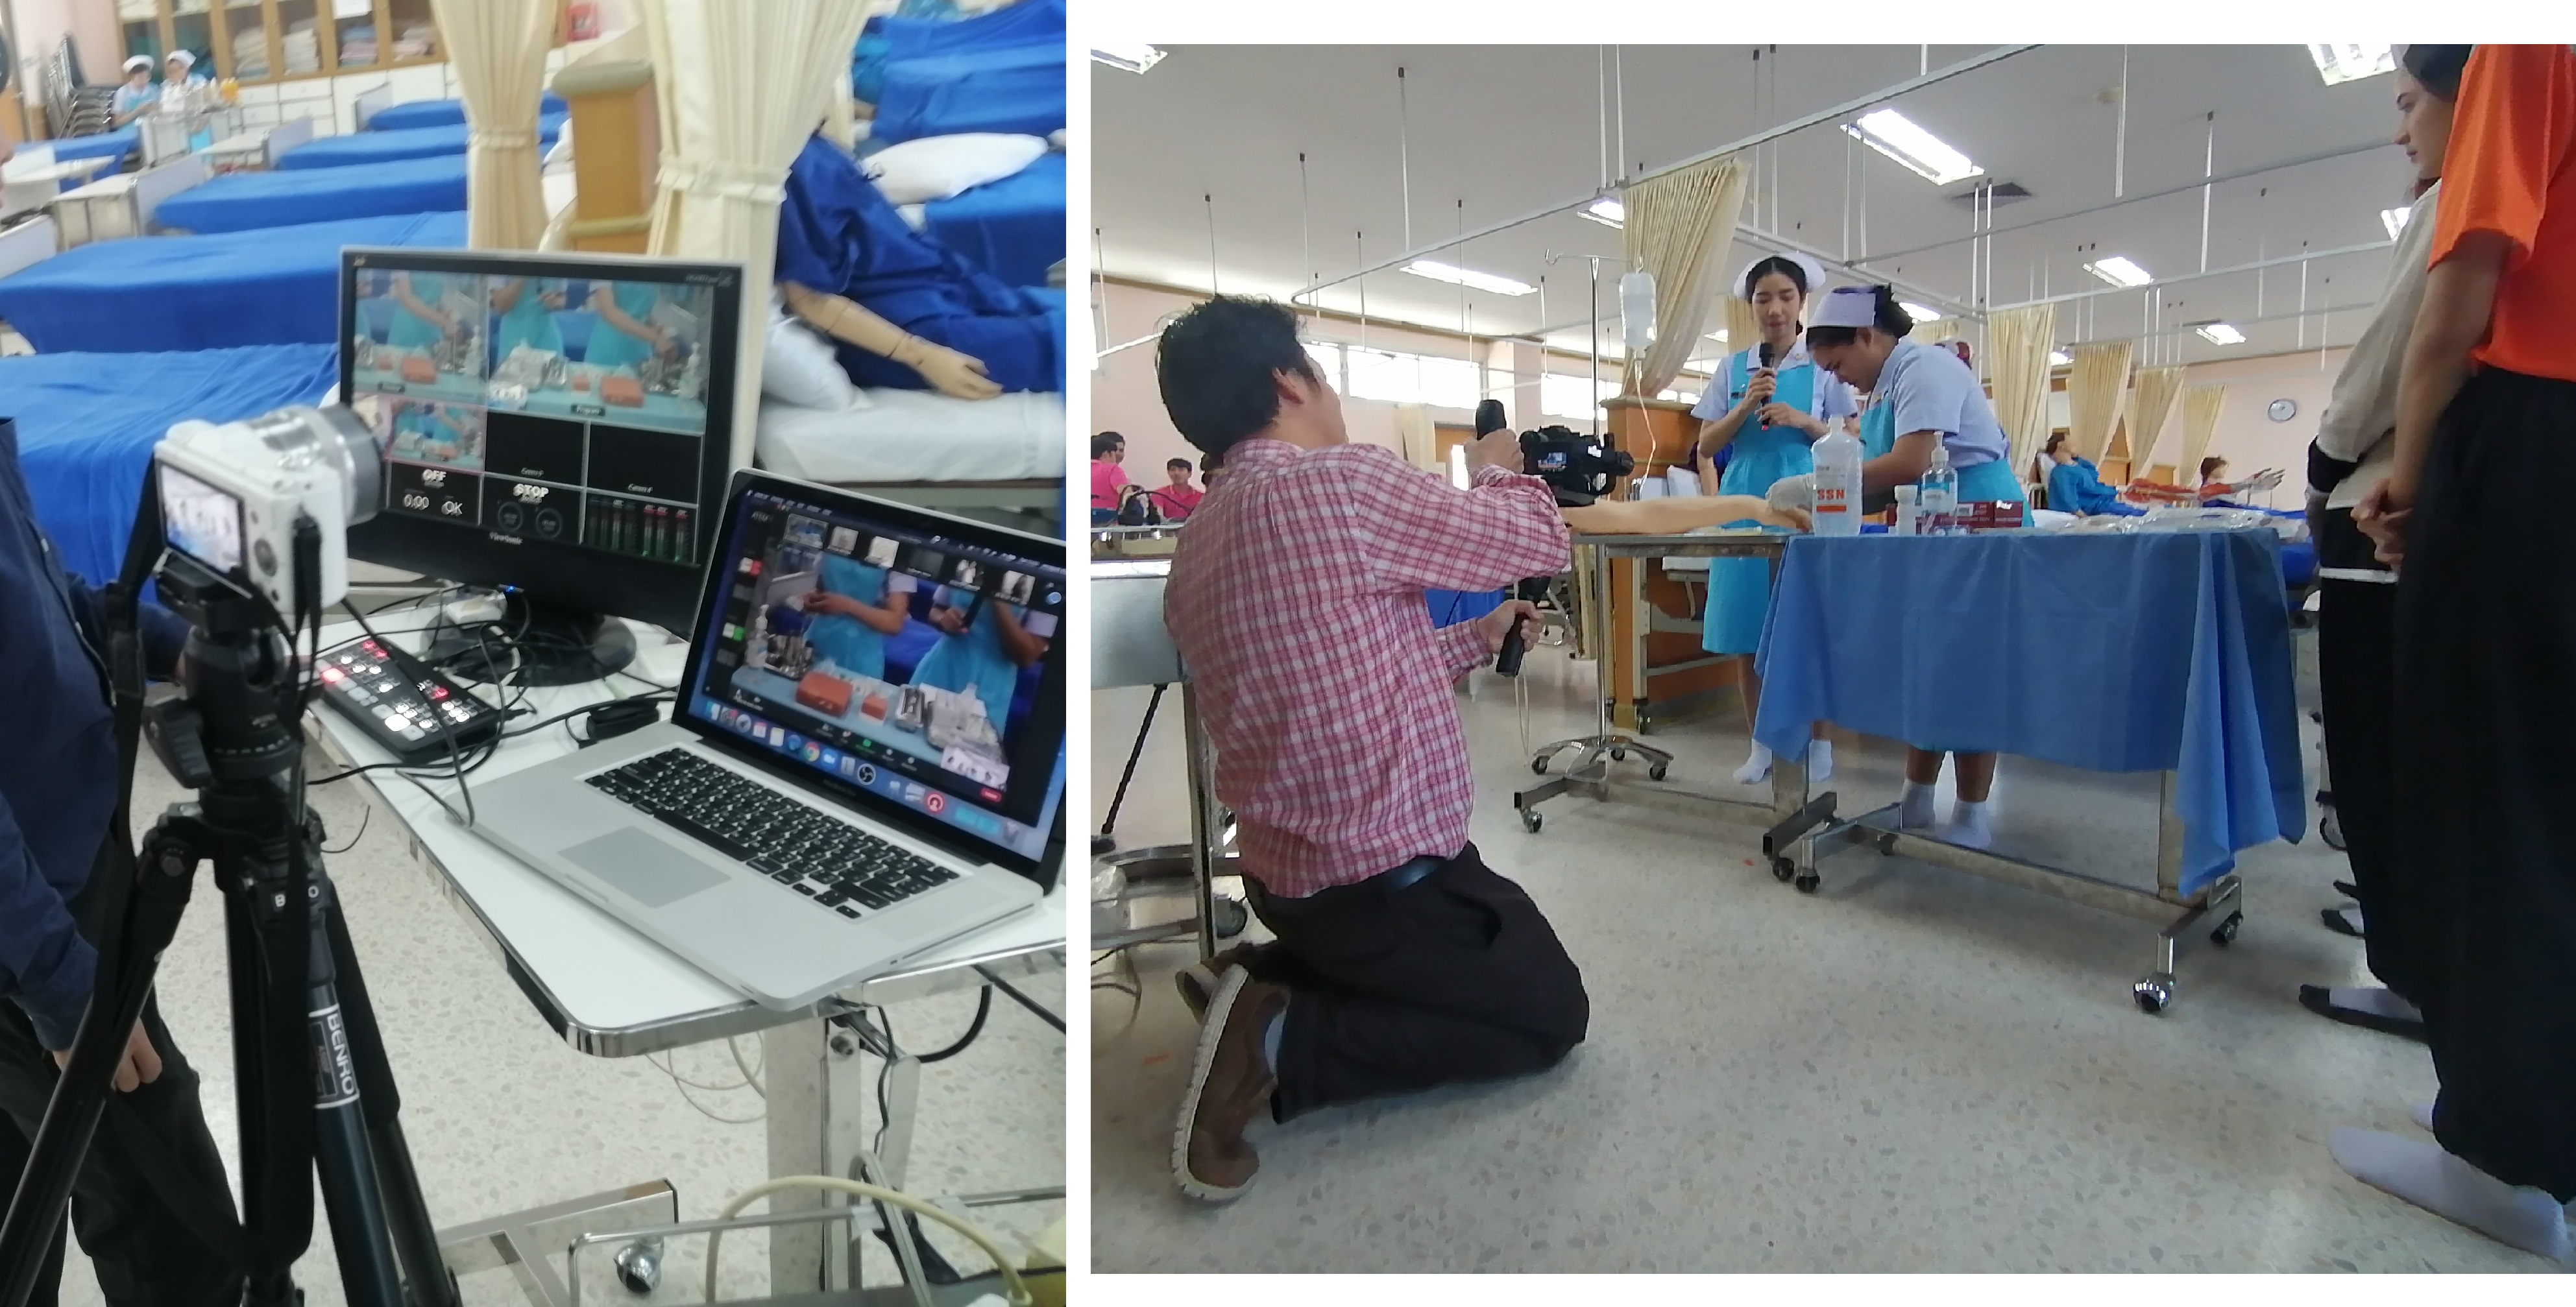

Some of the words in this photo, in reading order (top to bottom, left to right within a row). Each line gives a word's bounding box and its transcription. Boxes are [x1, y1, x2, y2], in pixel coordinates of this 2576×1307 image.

[422, 469, 447, 481] OFF
[513, 483, 549, 498] STOP
[1816, 488, 1845, 501] SSN
[403, 494, 430, 510] 0.00
[441, 501, 463, 517] OK
[489, 531, 524, 546] ViewSonic
[326, 1013, 355, 1095] BENRO
